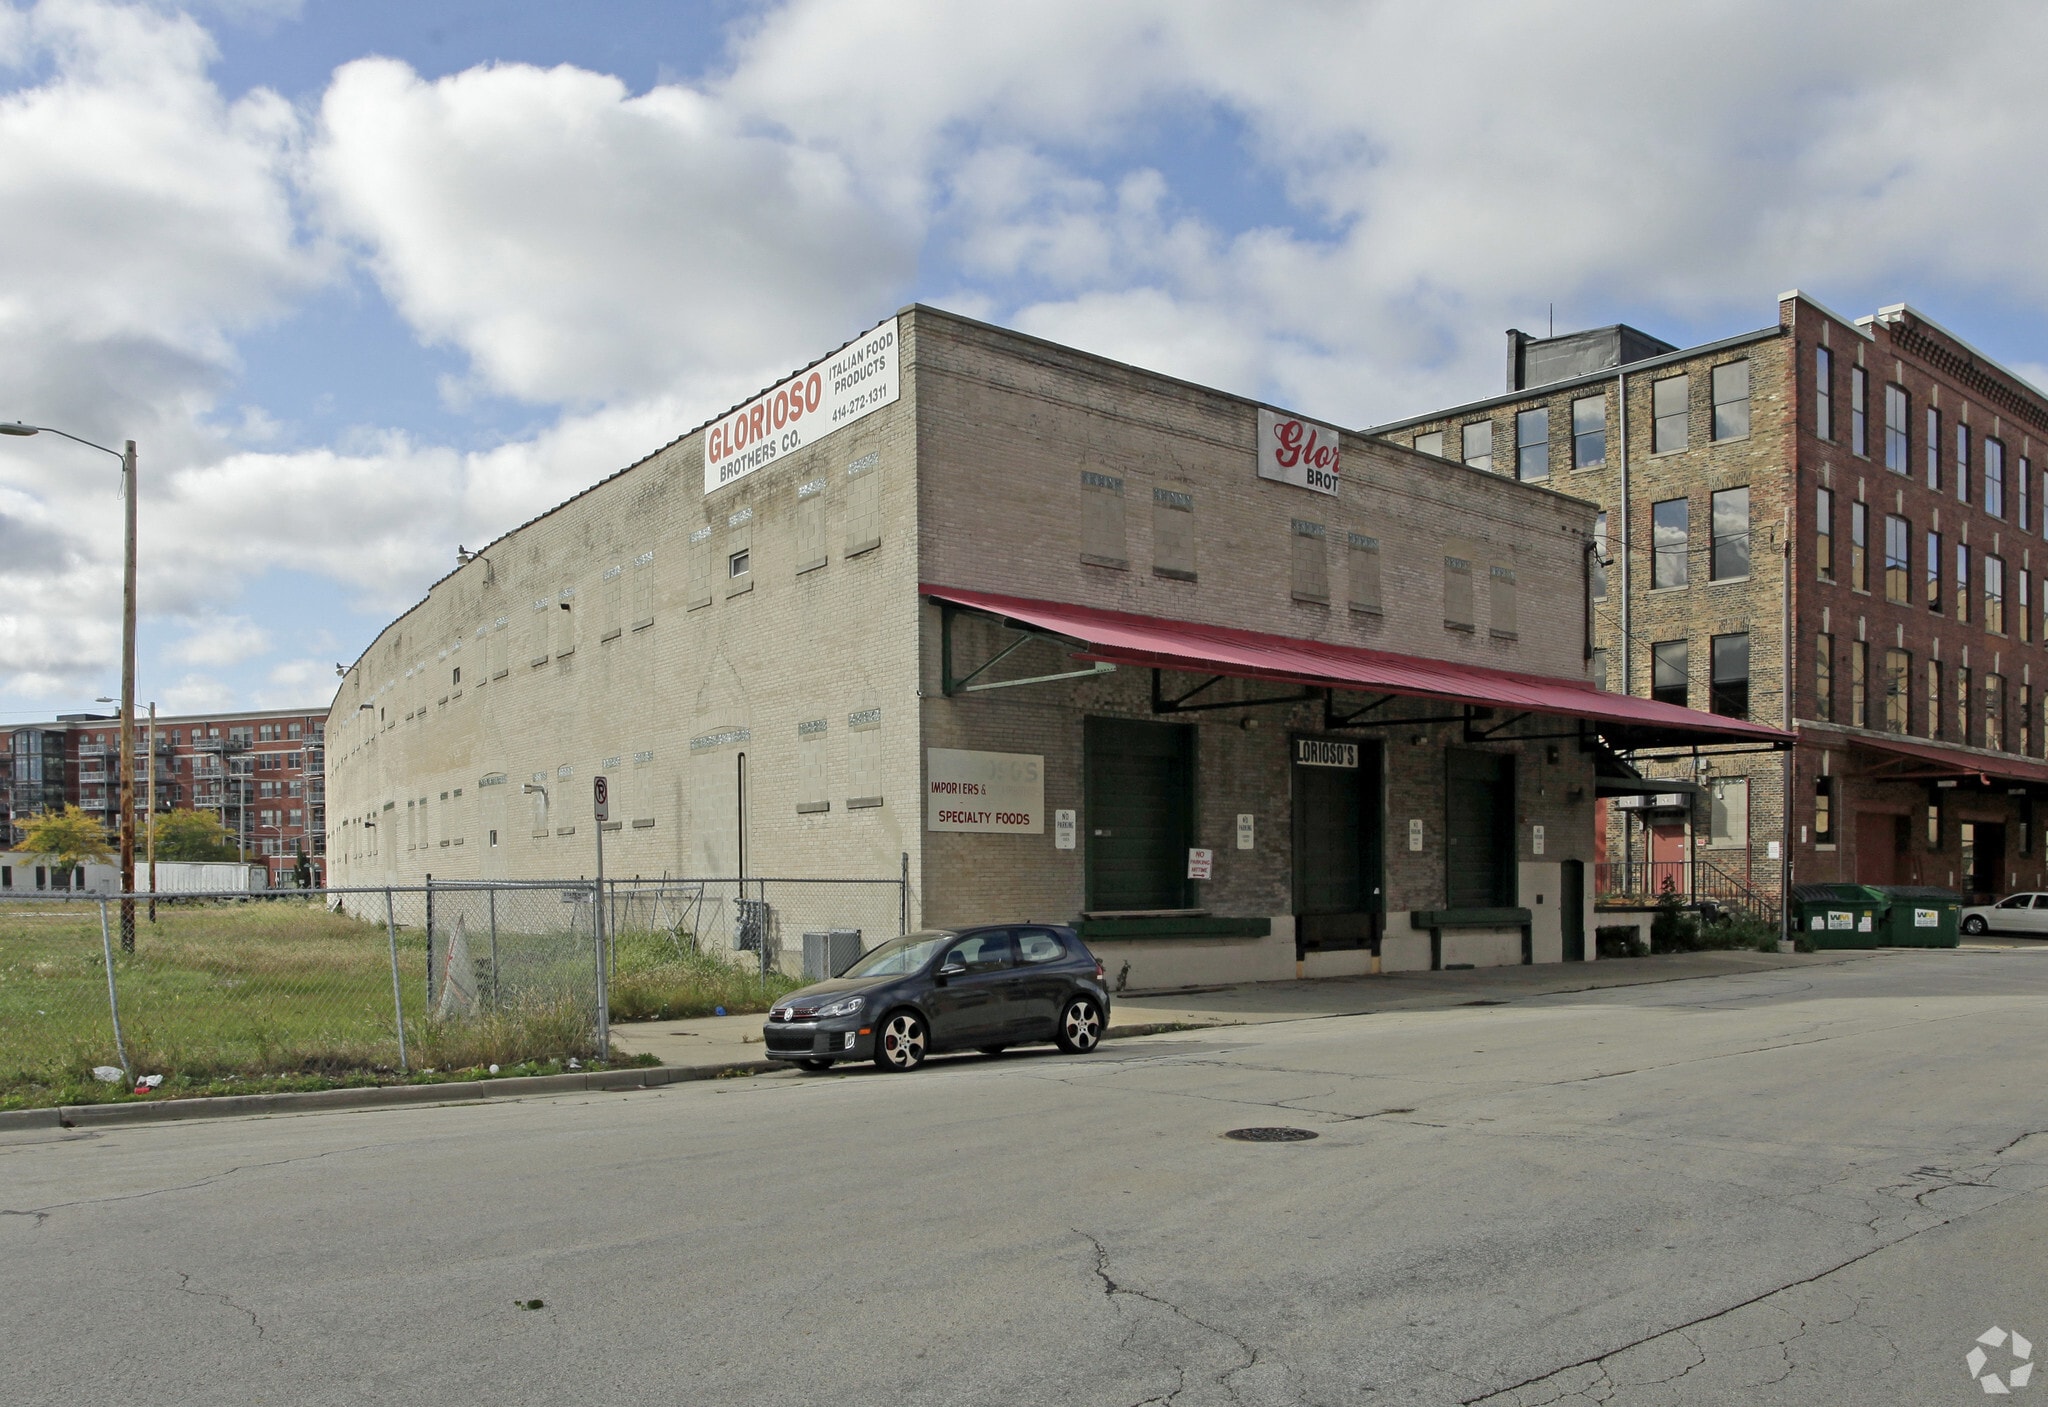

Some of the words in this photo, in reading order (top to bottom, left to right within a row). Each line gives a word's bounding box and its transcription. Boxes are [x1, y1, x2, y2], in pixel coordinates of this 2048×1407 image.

[829, 348, 864, 381] ITALIAN
[866, 331, 894, 359] FOOD
[834, 355, 886, 395] PRODUCTS
[708, 371, 822, 464] GLORIOSO
[832, 383, 887, 423] 414-272-1311
[720, 440, 776, 483] BROTHERS
[781, 429, 801, 453] CO.
[1273, 420, 1339, 474] Glor
[1307, 468, 1338, 492] BROT
[938, 810, 992, 824] SPECIALTY
[995, 812, 1030, 826] FOODS
[1062, 813, 1070, 821] NO
[1195, 850, 1205, 858] NO
